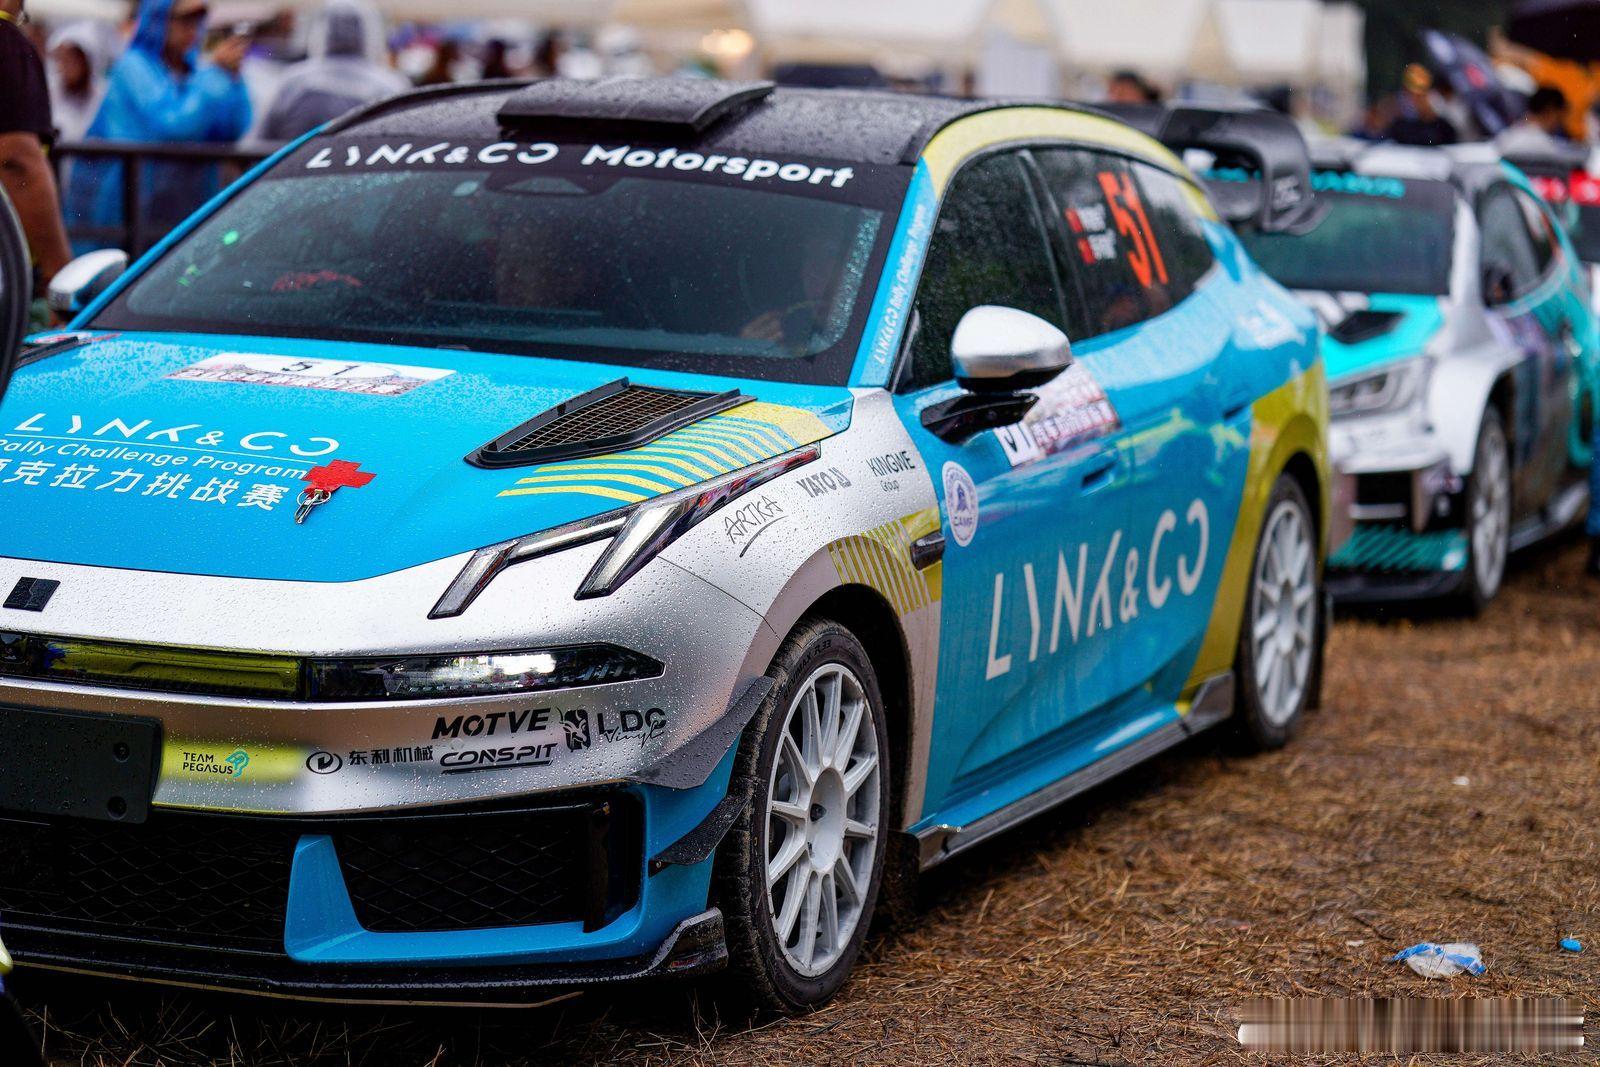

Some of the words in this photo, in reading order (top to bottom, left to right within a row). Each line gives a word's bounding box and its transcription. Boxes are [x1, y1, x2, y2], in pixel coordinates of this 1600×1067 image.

[581, 143, 855, 189] Motorsport
[57, 443, 188, 467] Challenge
[193, 455, 308, 480] Program
[866, 450, 916, 478] KINGWE
[880, 479, 901, 493] Group
[431, 707, 551, 740] MOTVE
[183, 752, 215, 764] TEAM
[350, 745, 434, 766] 东利机械
[439, 742, 559, 767] CONSPIT
[182, 761, 234, 775] PEGASUS
